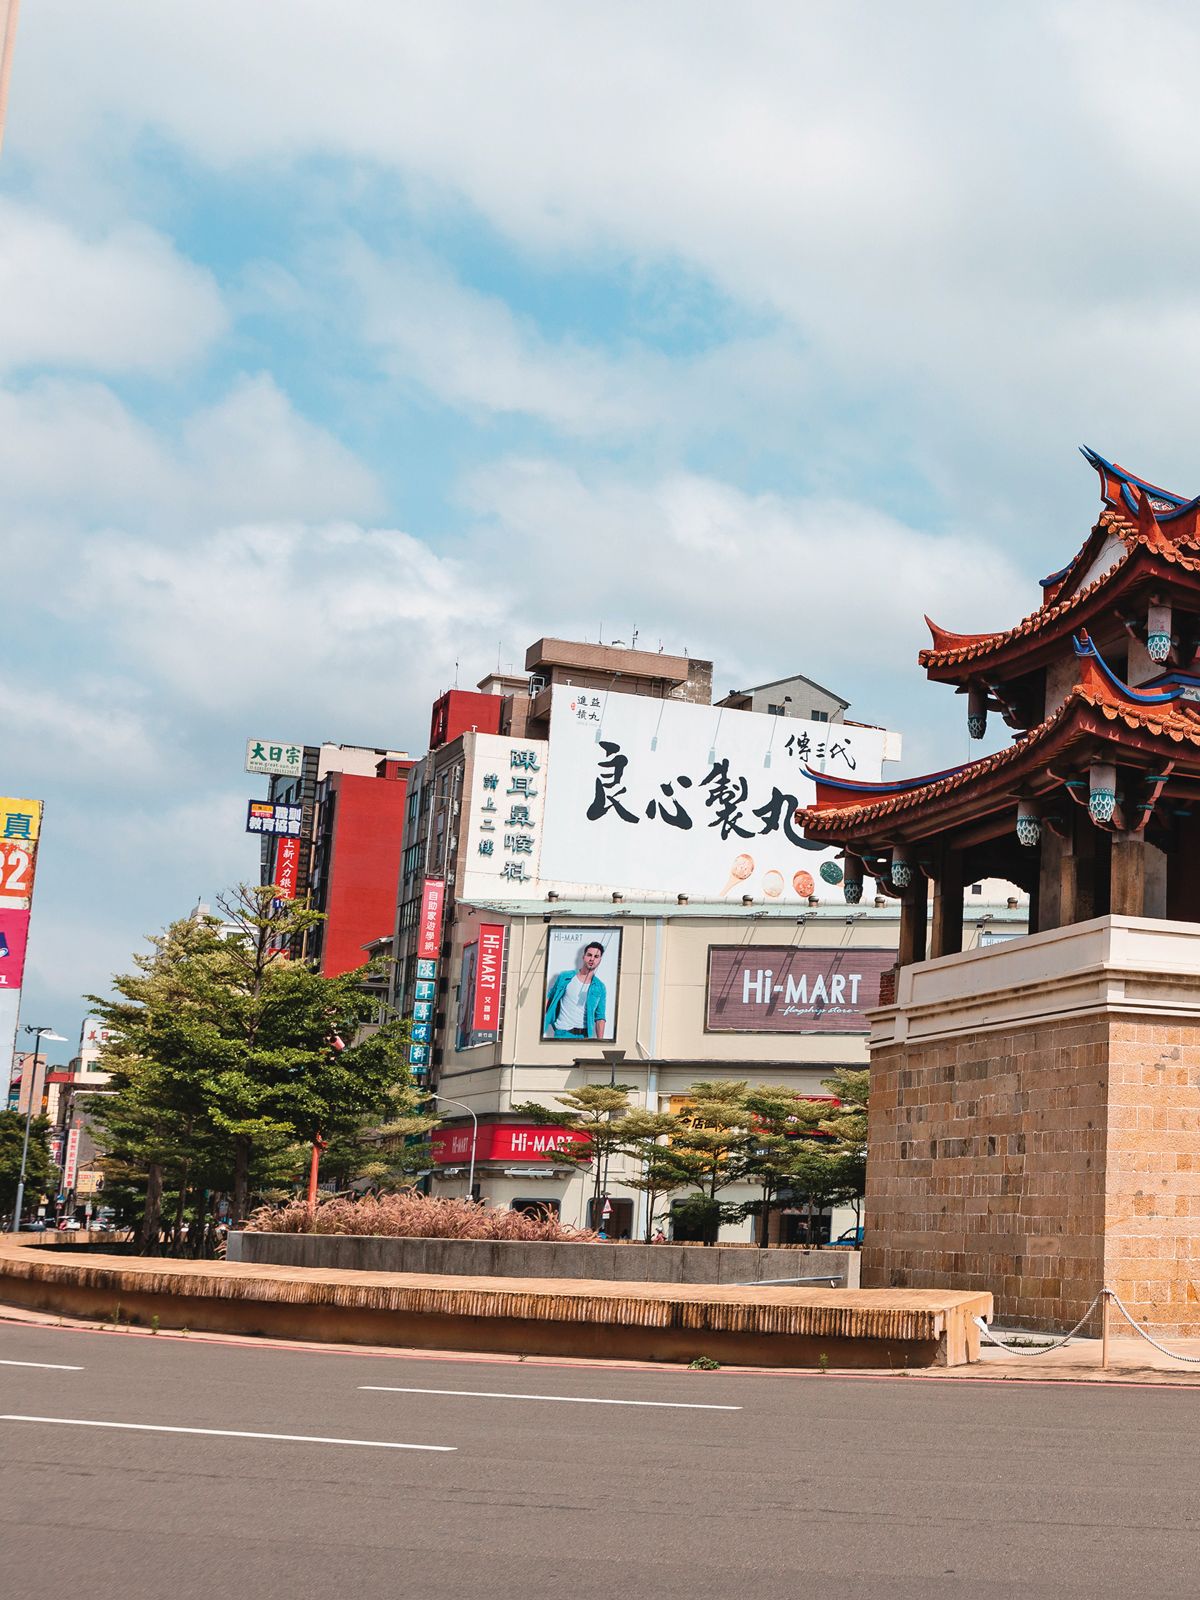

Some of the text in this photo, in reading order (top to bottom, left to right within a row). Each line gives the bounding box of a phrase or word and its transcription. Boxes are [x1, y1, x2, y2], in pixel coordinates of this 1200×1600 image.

[251, 742, 301, 765] 大日宗
[478, 772, 499, 857] 請上二樓
[500, 748, 541, 884] 陳耳鼻喉科
[586, 740, 832, 852] 良心製丸
[4, 812, 33, 840] 真
[248, 816, 302, 835] 教育協會
[0, 847, 29, 892] 2
[553, 933, 583, 942] Hi-MART
[481, 934, 500, 989] Hi-MART
[742, 969, 862, 1004] Hi-MART
